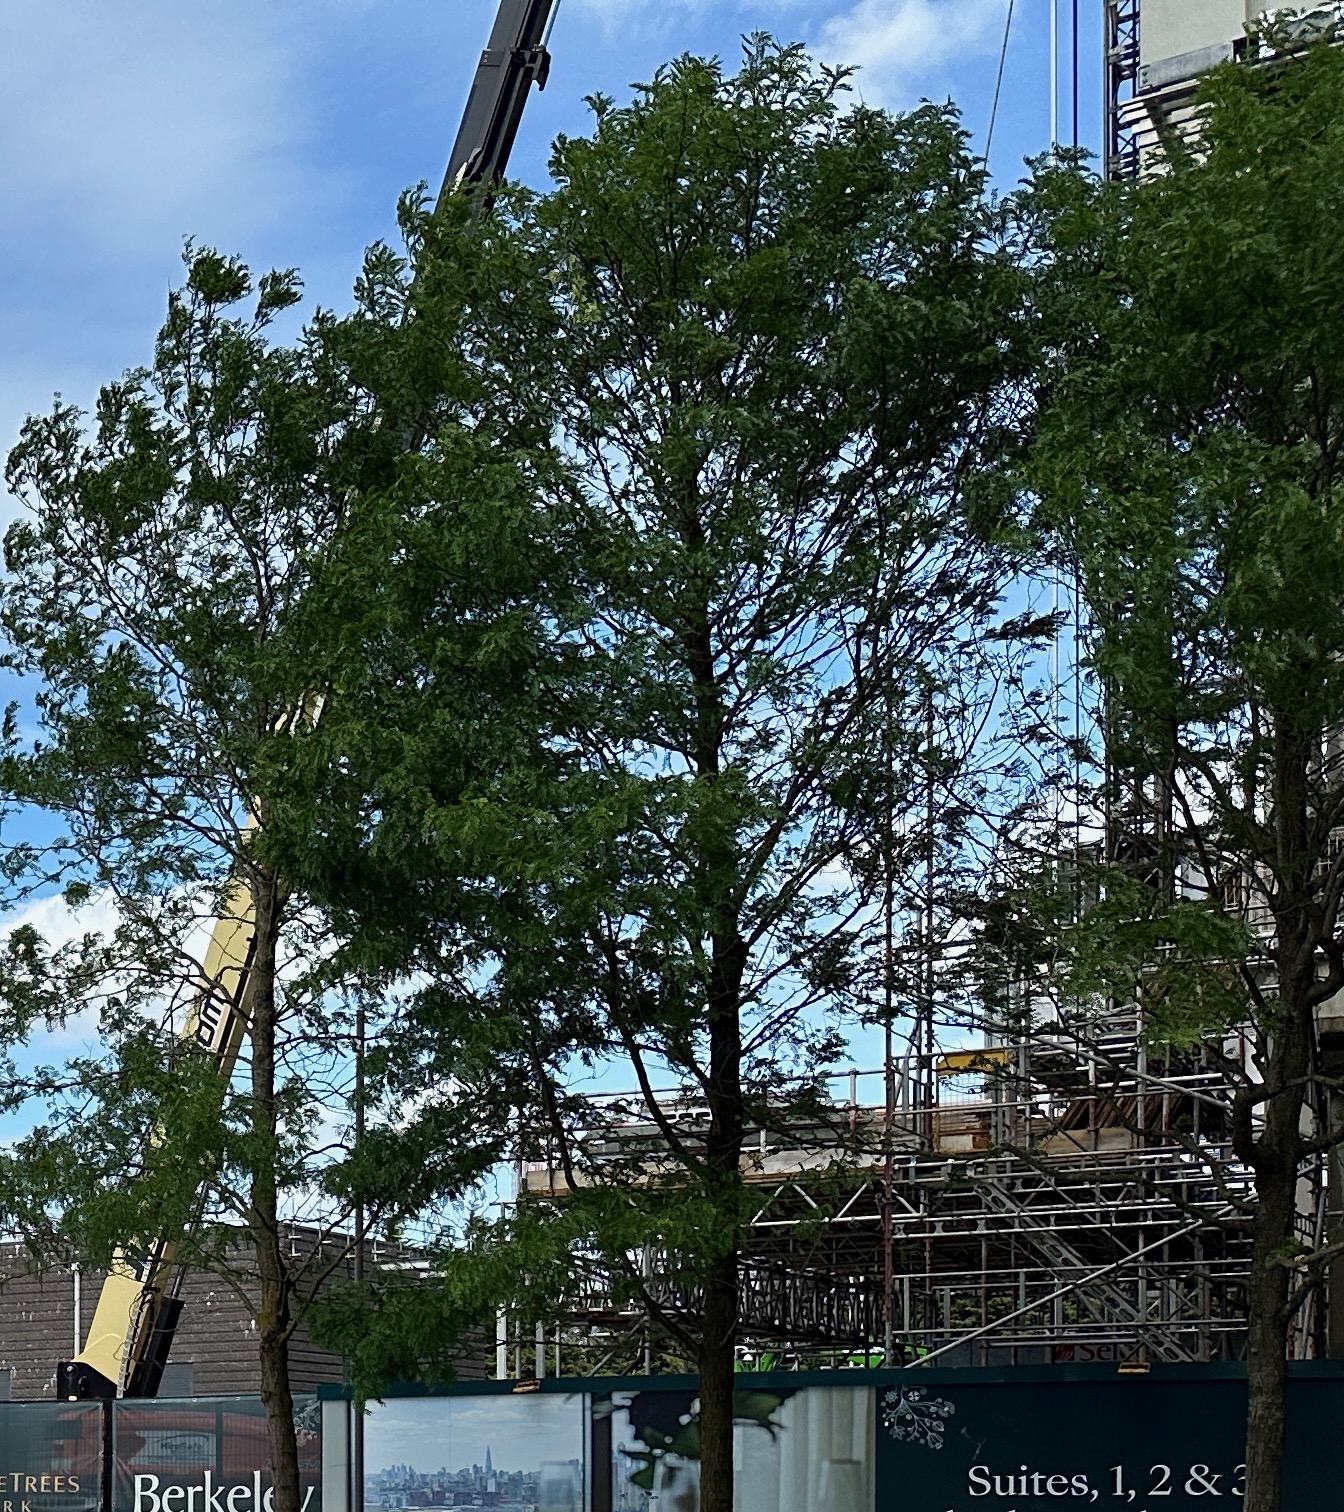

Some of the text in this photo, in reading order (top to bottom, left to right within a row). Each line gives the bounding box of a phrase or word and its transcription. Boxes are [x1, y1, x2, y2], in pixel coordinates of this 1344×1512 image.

[968, 1463, 1247, 1503] Suites, 1, 2 & 3
